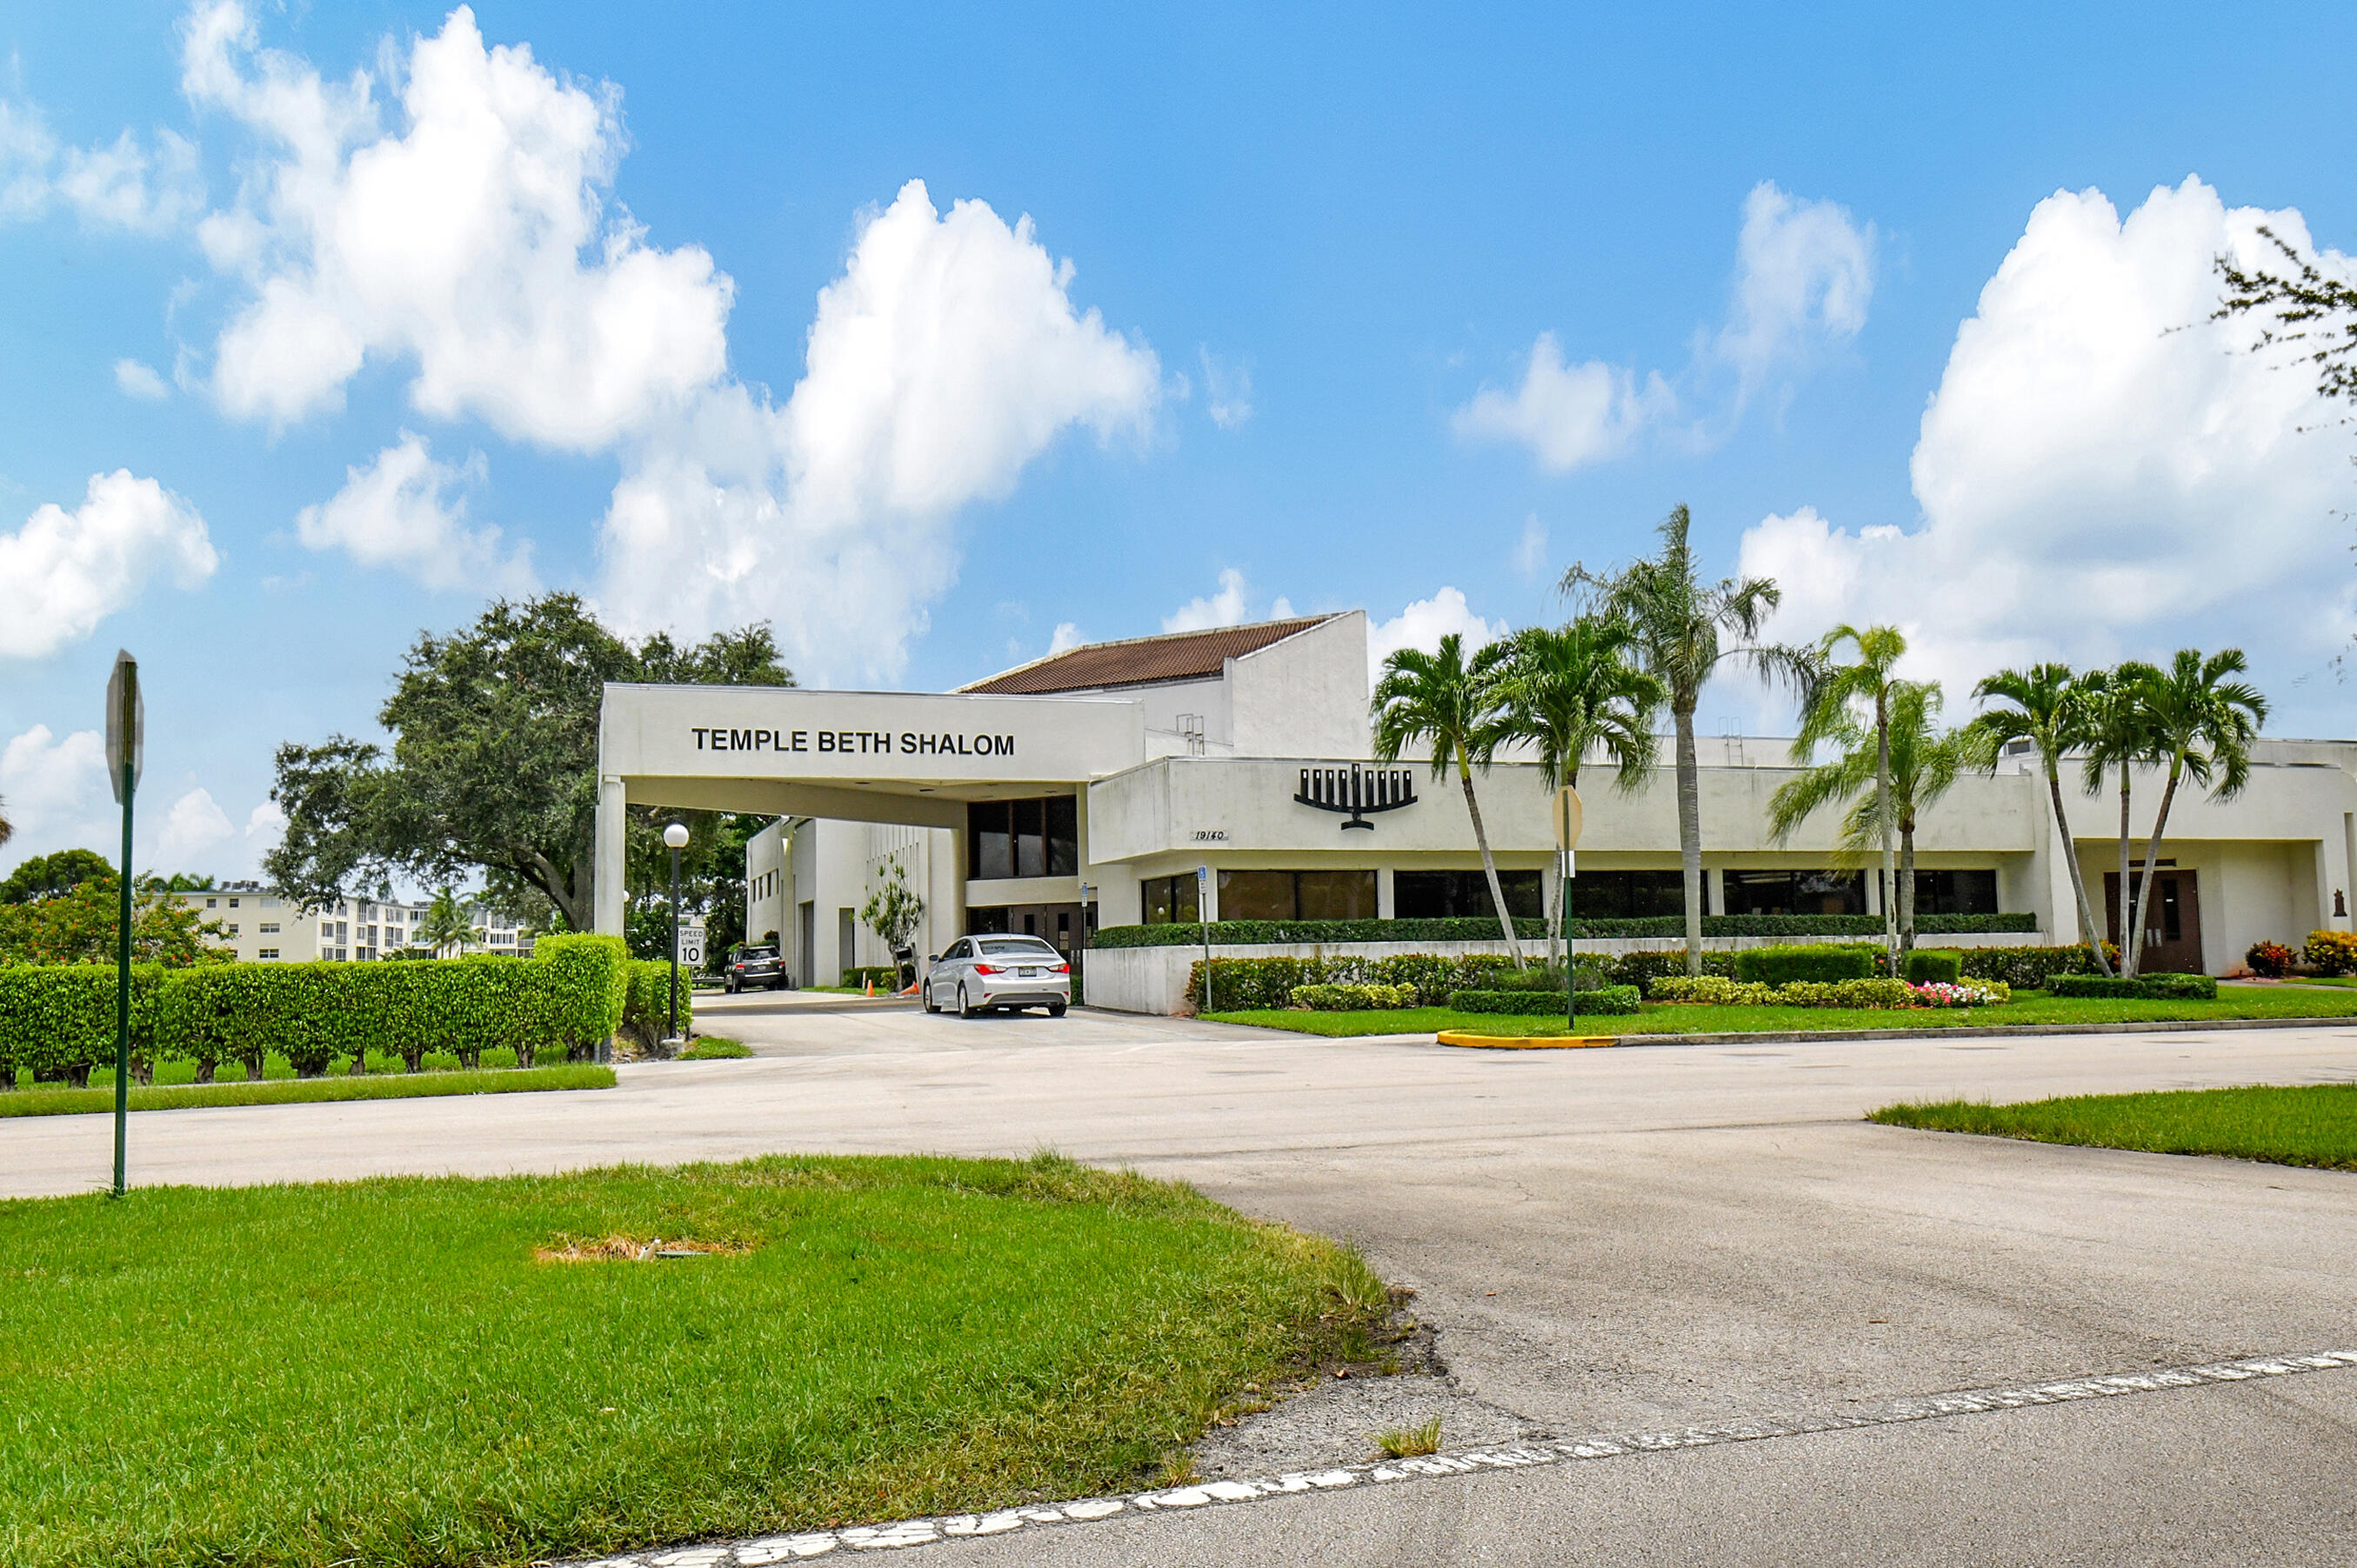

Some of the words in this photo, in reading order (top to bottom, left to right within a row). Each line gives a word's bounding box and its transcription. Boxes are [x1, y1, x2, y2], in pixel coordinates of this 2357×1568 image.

[691, 728, 808, 752] TEMPLE
[818, 731, 891, 754] BETH
[900, 732, 1015, 756] SHALOM
[1196, 831, 1224, 840] 19140
[682, 947, 699, 962] 10
